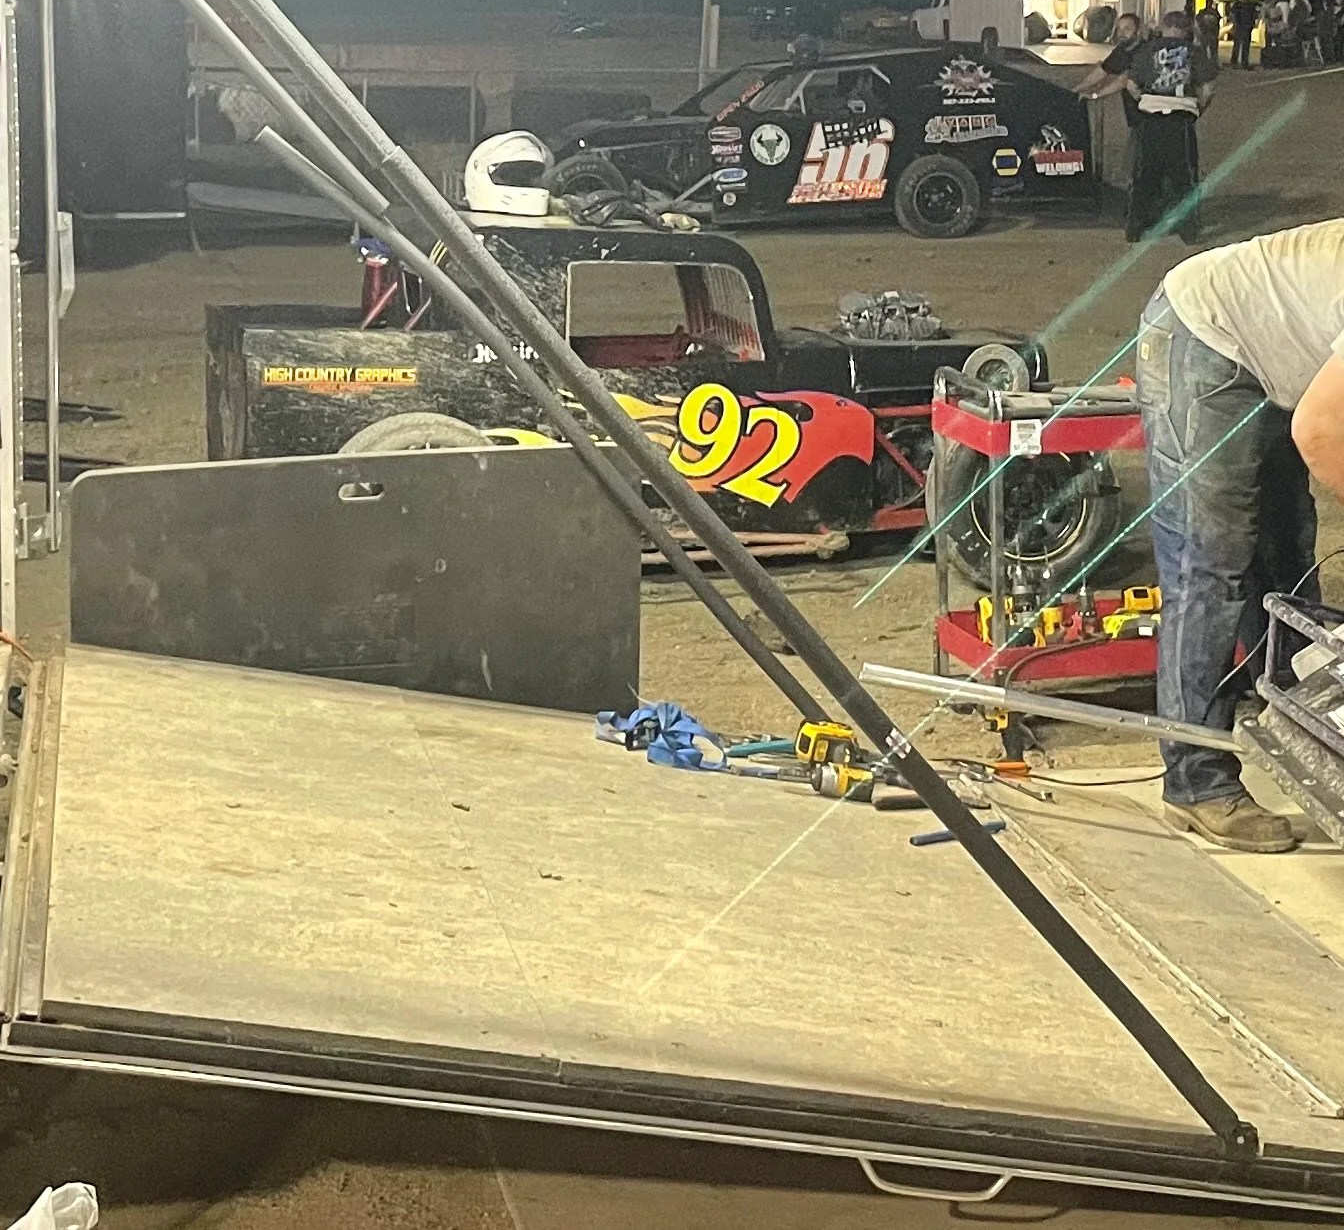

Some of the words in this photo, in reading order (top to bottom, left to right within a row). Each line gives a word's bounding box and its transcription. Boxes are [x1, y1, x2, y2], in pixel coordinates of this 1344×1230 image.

[264, 367, 293, 382] HIGH
[295, 367, 353, 383] COUNTRY
[355, 367, 417, 383] GRAPHICS
[668, 382, 802, 508] 92
